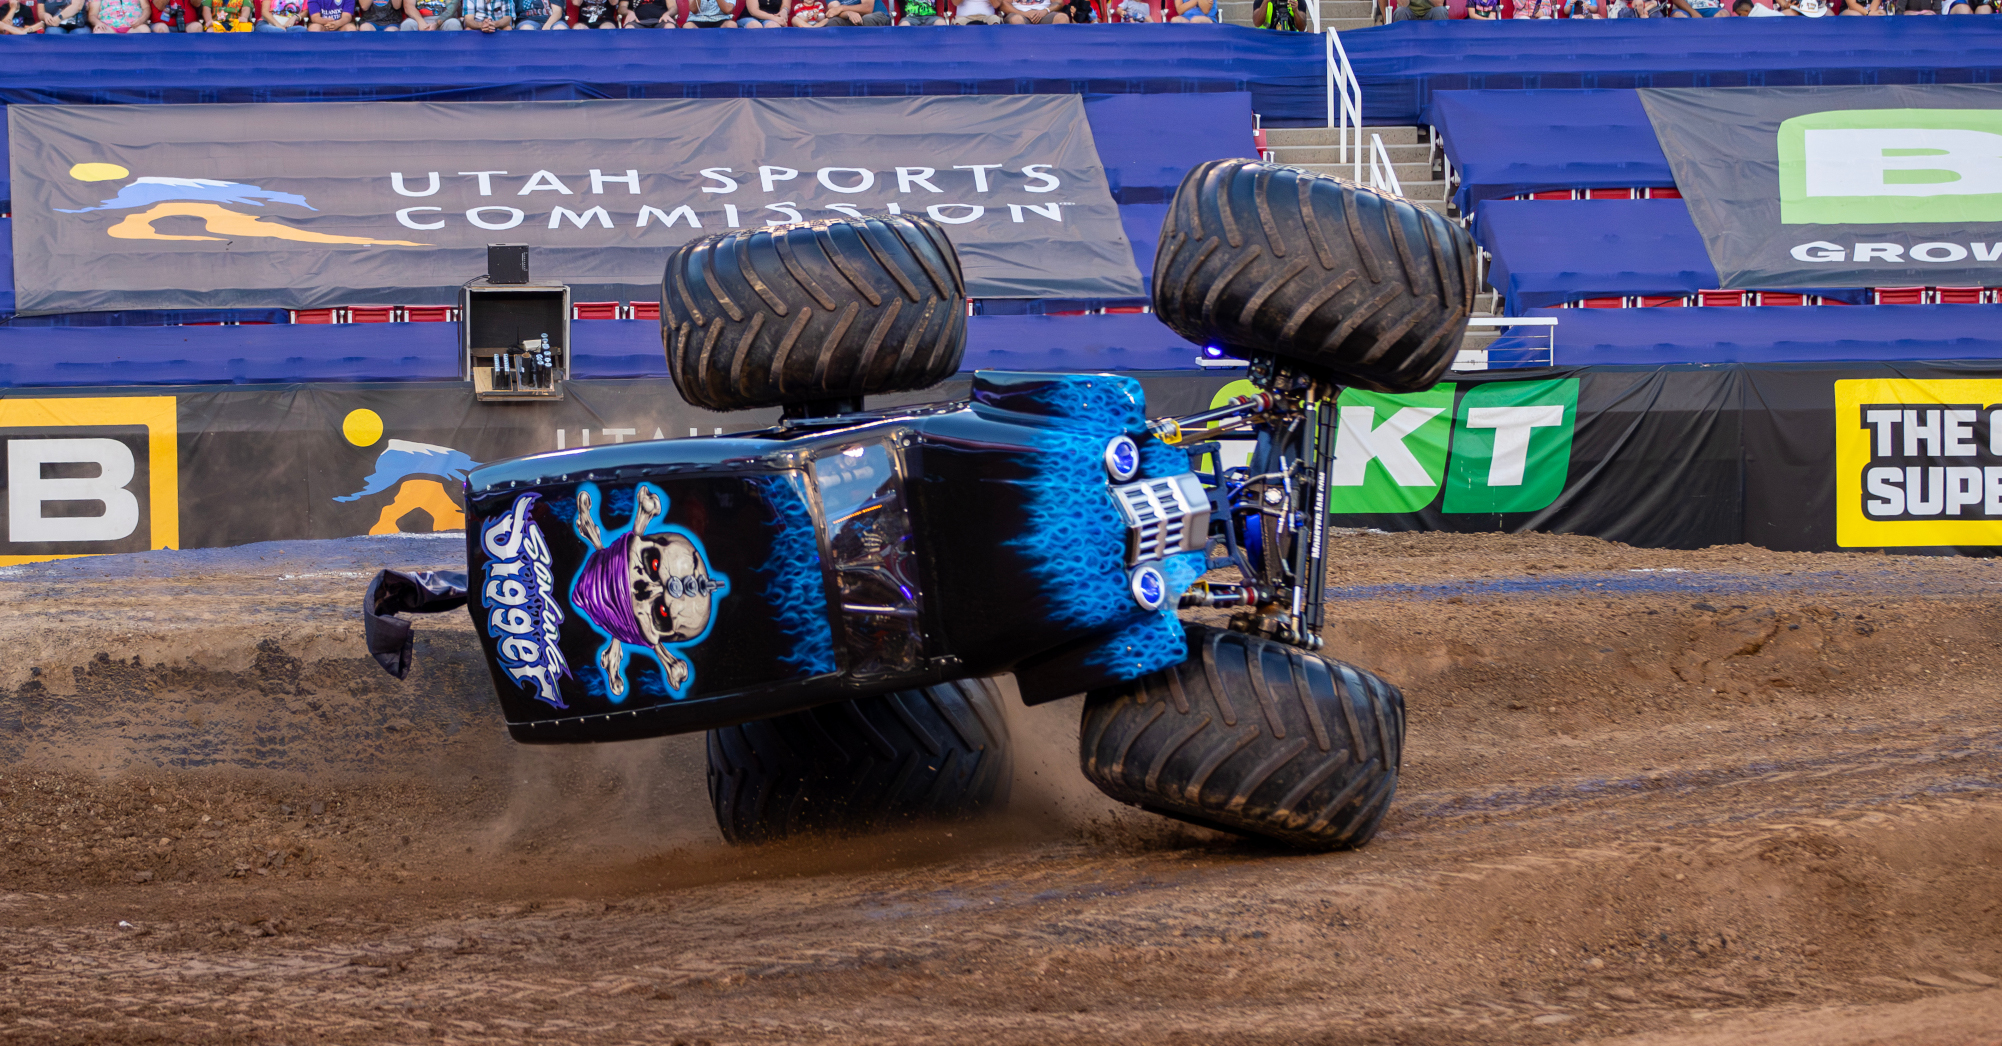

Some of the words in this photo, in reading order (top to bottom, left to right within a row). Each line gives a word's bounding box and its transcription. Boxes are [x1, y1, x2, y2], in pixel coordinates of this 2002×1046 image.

[390, 169, 641, 197] UTAH
[699, 164, 1061, 194] SPORTS
[1867, 409, 1977, 457] THE
[8, 438, 140, 542] B
[484, 497, 556, 702] Digger
